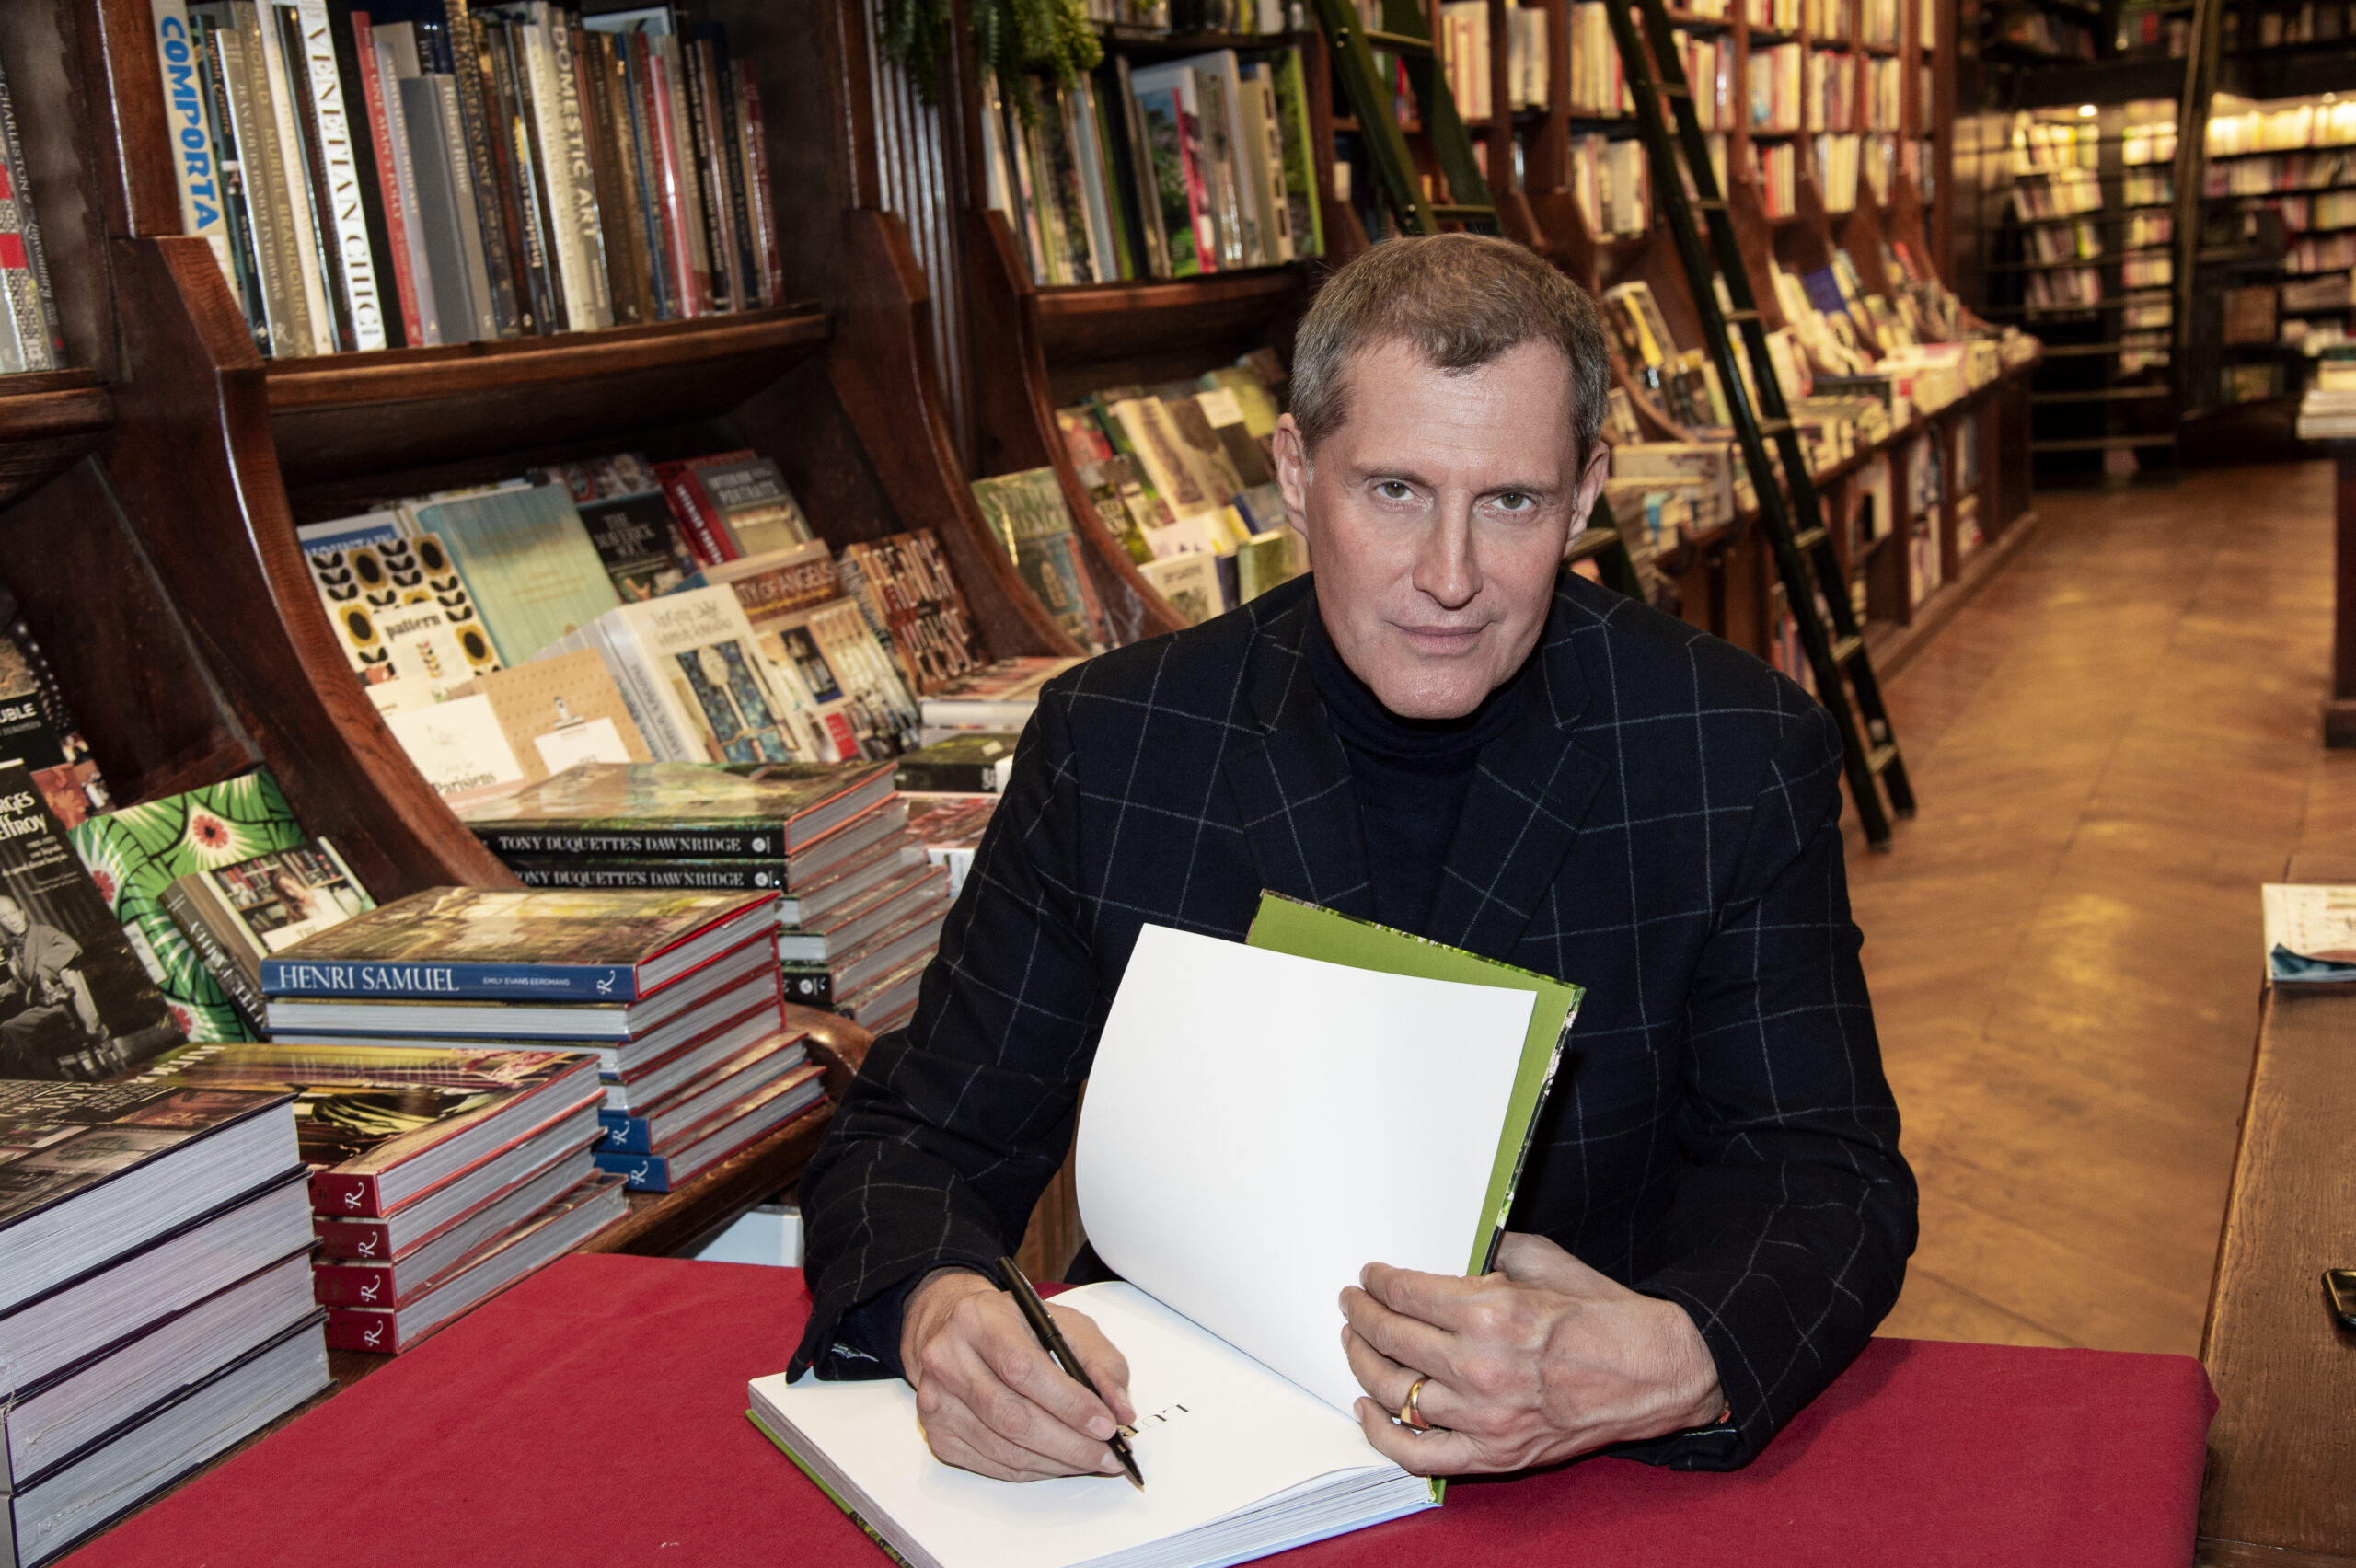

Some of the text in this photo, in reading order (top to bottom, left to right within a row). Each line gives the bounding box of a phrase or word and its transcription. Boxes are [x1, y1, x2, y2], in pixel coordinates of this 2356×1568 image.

[0, 81, 31, 191] CHARLESTON
[161, 16, 219, 229] COMPORTA
[442, 85, 464, 144] Robert
[549, 23, 591, 179] DOMESTIC
[575, 185, 599, 238] ART
[262, 126, 287, 196] MURIEL
[307, 26, 358, 221] VENETIAN
[344, 233, 380, 328] CHIC
[274, 202, 310, 322] BRANDOLINI
[699, 528, 724, 566] PORTRA
[778, 560, 836, 595] ANGELS
[385, 615, 442, 643] pattern
[499, 836, 741, 853] TONY DUQUETTE'S DAWNRIDGE
[554, 871, 647, 887] DUQUETTE'S
[648, 872, 745, 888] DAWNRIDGE
[279, 965, 354, 990] HENRI
[362, 967, 460, 992] SAMUEL
[482, 976, 503, 986] EMILY
[504, 976, 528, 986] EVANS
